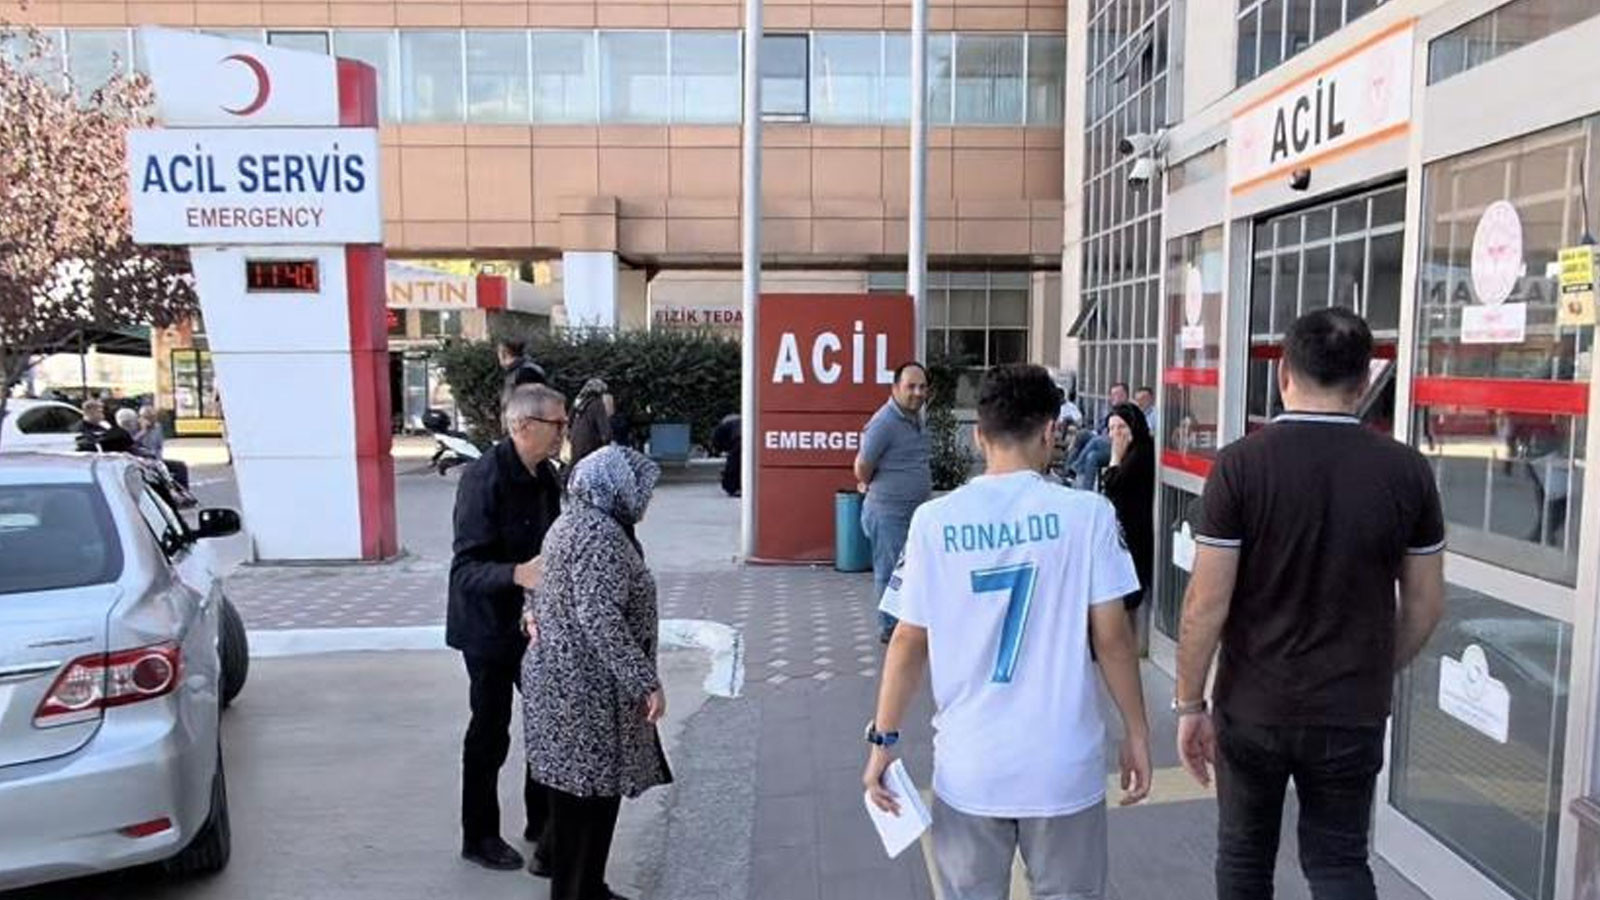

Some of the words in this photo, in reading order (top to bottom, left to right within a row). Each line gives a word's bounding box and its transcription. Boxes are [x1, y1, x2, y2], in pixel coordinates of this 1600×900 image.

[1270, 78, 1345, 163] ACİL
[142, 143, 226, 193] ACİL
[237, 143, 366, 193] SERVİS
[186, 207, 323, 228] EMERGENCY
[772, 320, 896, 384] ACİL
[765, 431, 865, 449] EMERGE
[943, 513, 1061, 552] RONALDO
[970, 562, 1039, 684] 7
